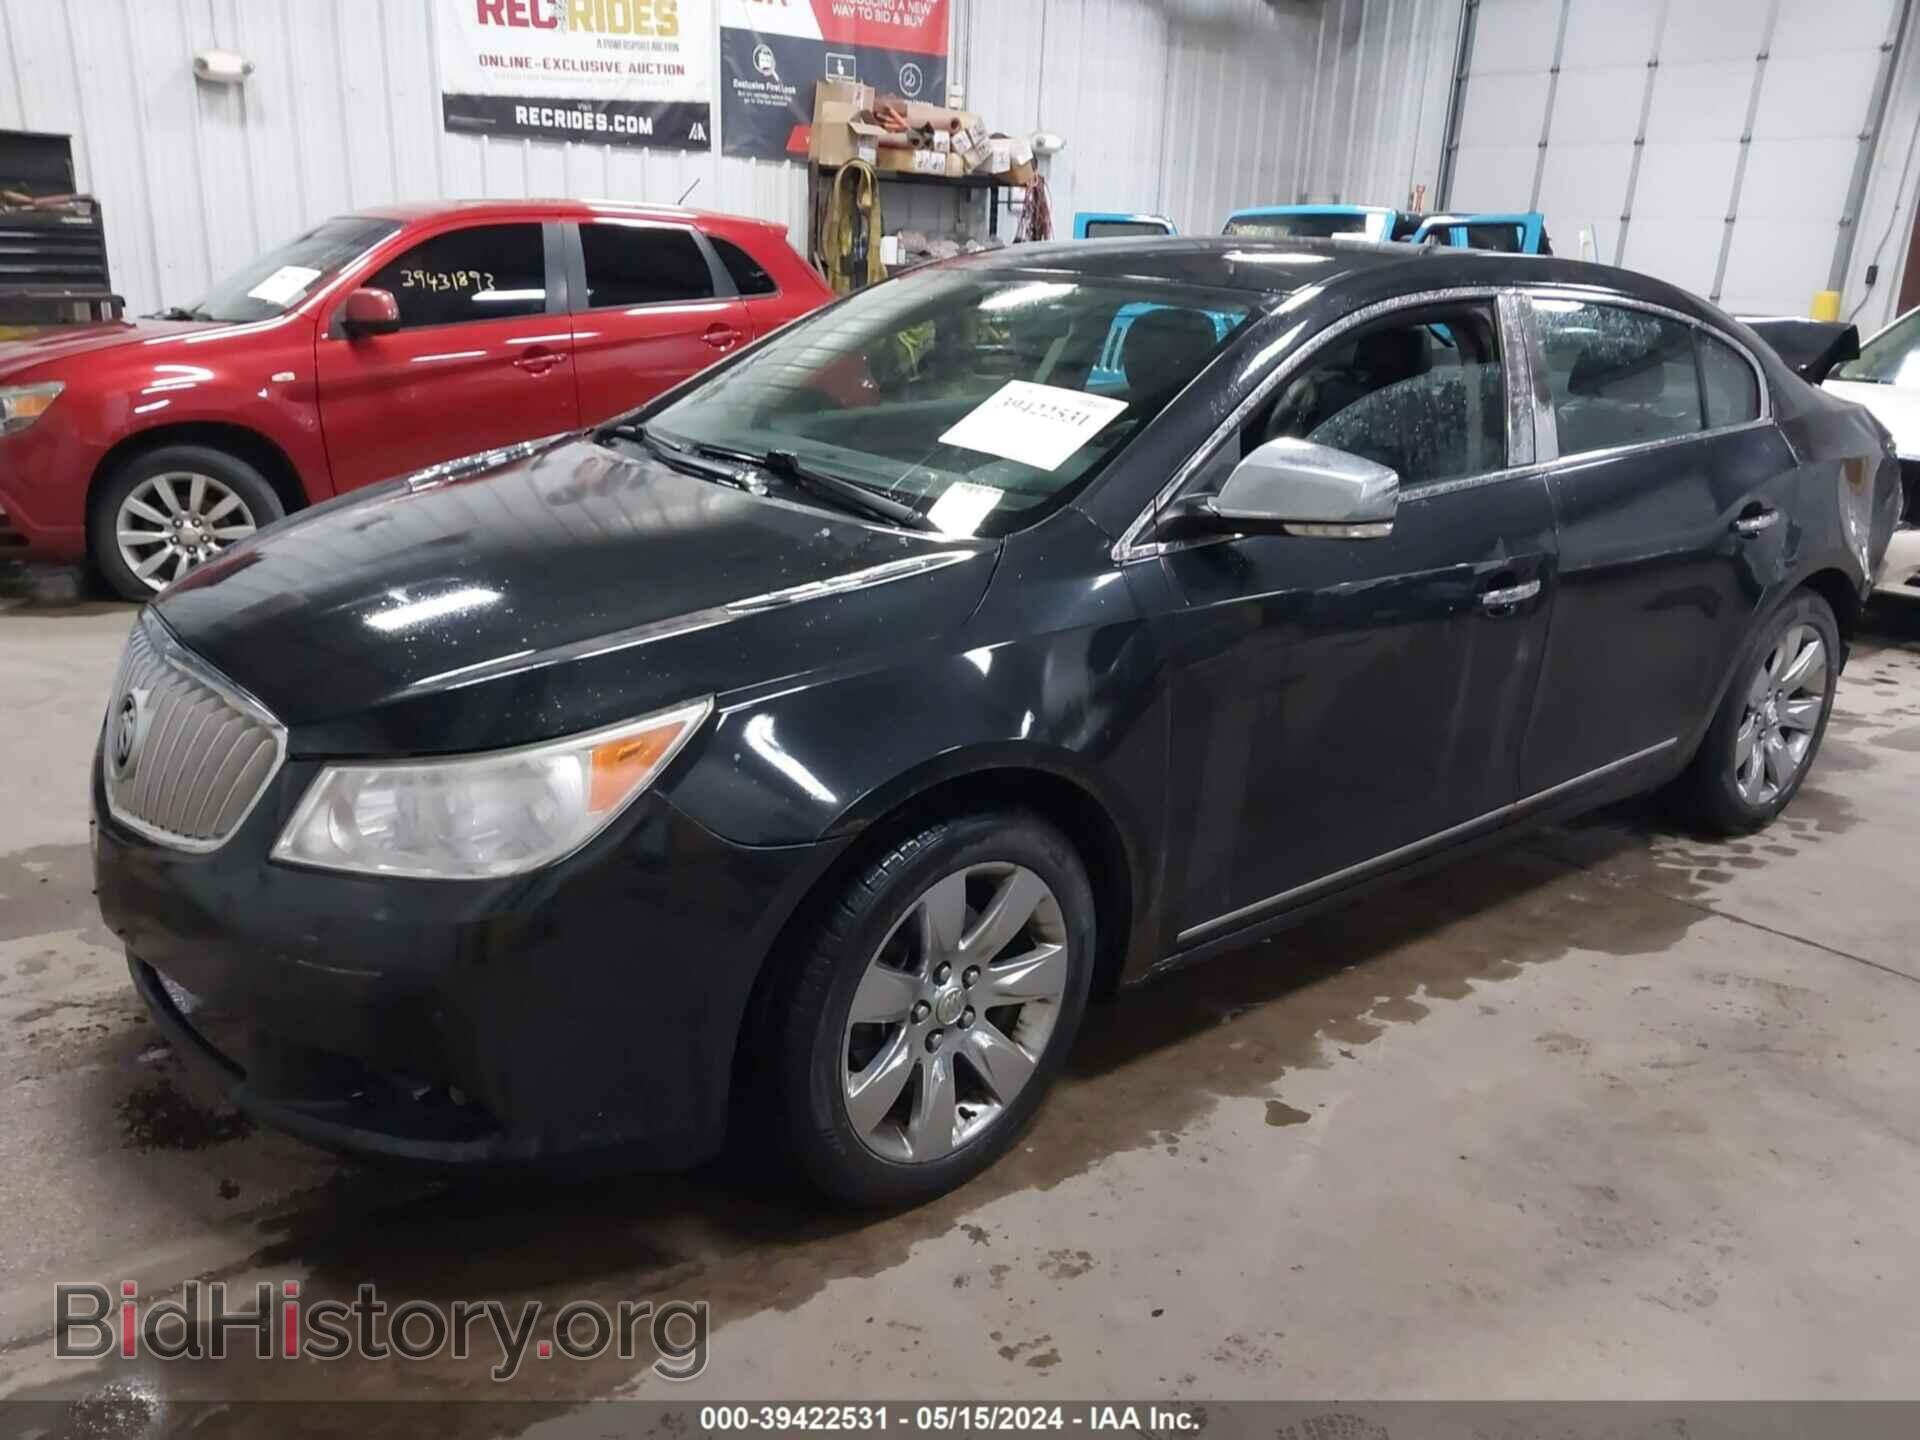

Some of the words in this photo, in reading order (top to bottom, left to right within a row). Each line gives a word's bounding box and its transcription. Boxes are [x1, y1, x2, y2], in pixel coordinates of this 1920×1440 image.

[476, 0, 558, 29] REC
[568, 0, 680, 36] RIDES
[832, 2, 855, 16] WAY
[858, 6, 873, 20] TO
[875, 9, 891, 23] BID
[903, 14, 925, 27] BUY
[909, 1, 931, 14] NEW
[478, 54, 622, 73] ONLINE-EXCLUSIVE
[628, 62, 685, 75] AUCTION
[515, 105, 653, 134] RECRIDES.COM
[400, 270, 496, 292] 39431893
